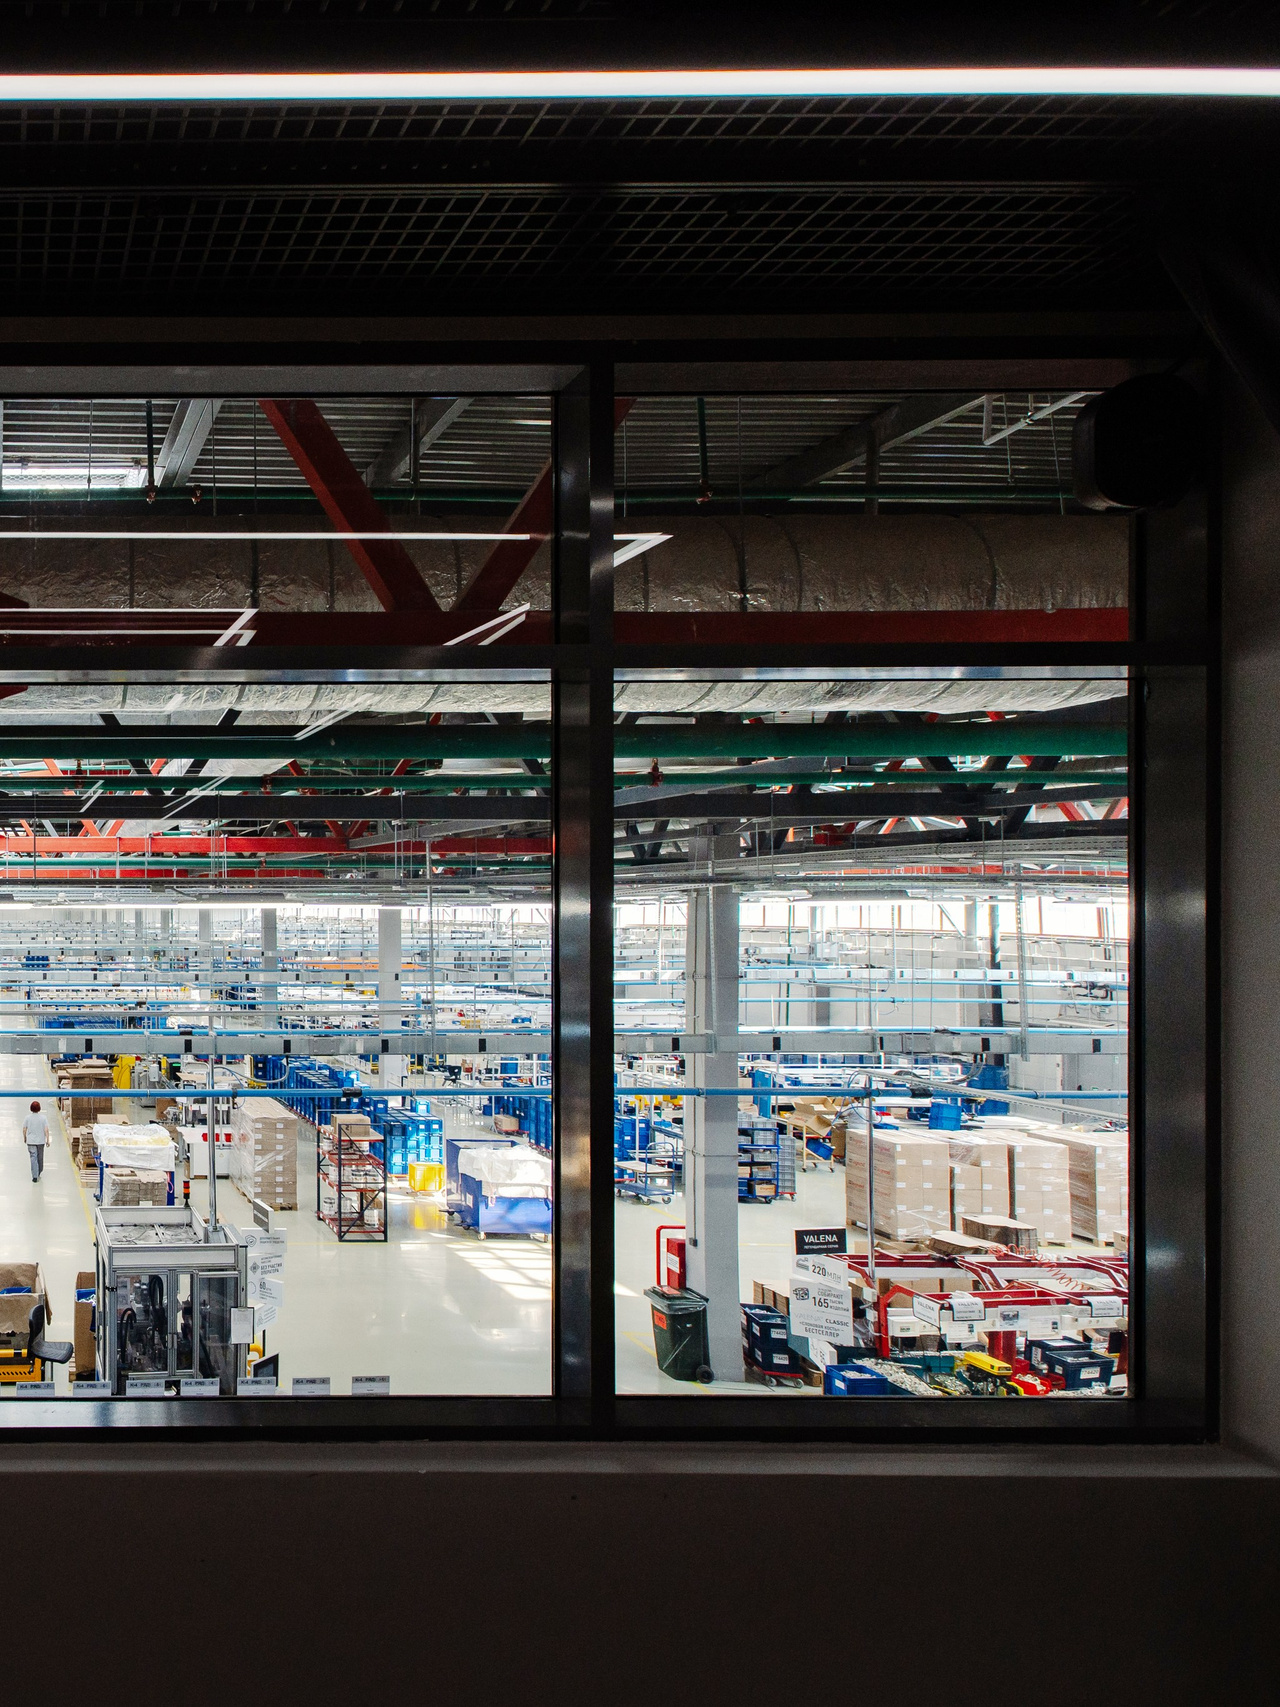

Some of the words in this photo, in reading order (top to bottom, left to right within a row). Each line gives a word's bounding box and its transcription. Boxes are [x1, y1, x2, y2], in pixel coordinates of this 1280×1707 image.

[803, 1234, 838, 1243] VALENA
[812, 1264, 827, 1277] 220
[827, 1271, 841, 1281] МЛН
[260, 1281, 266, 1290] 60
[817, 1291, 843, 1300] СОБИРАЮТ
[812, 1296, 829, 1309] 165
[825, 1318, 850, 1327] CLASSIC
[804, 1326, 839, 1338] БЕСТСЕЛЛЕР
